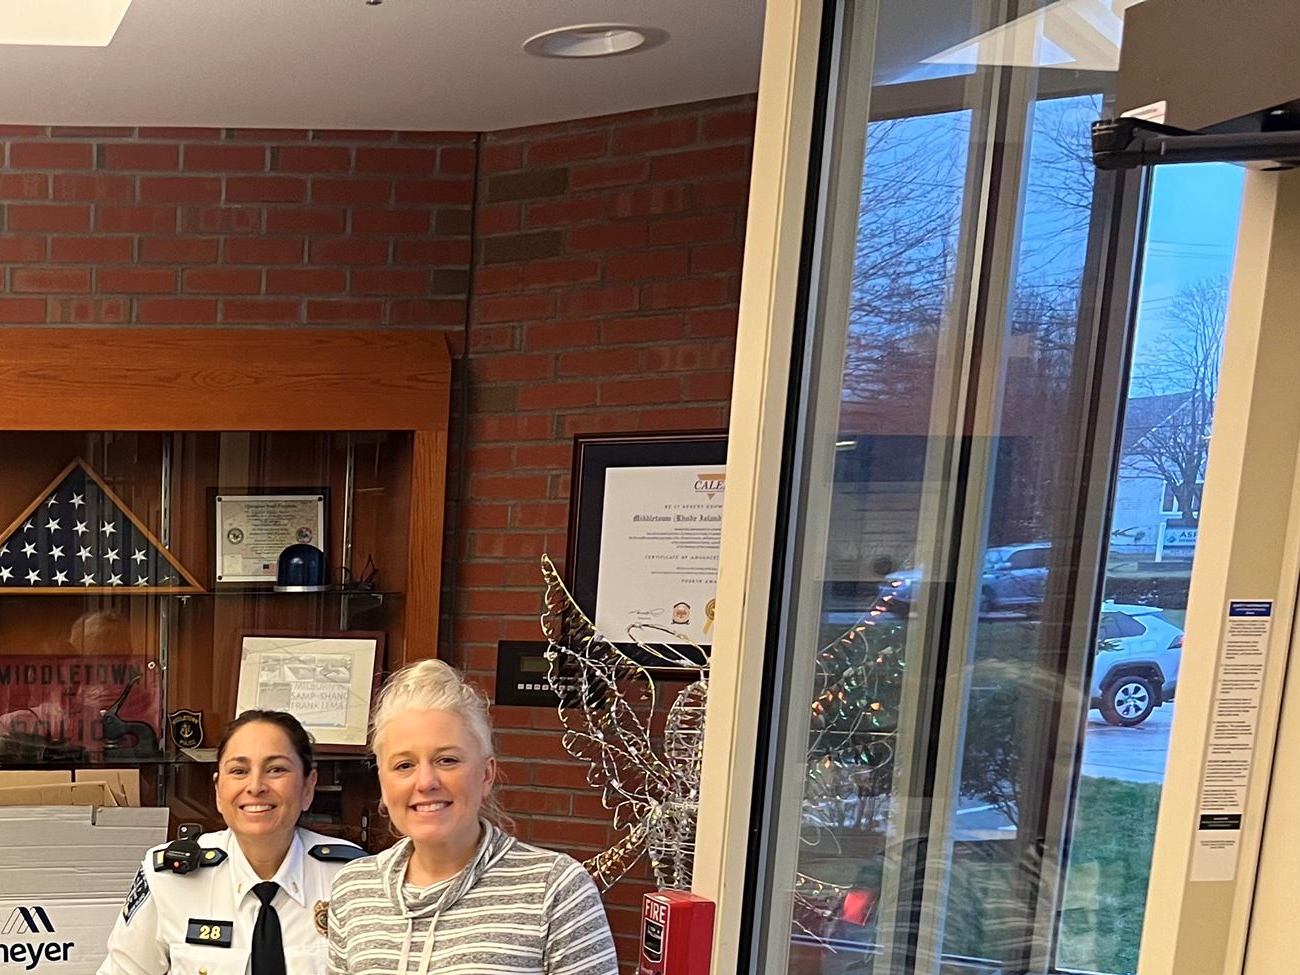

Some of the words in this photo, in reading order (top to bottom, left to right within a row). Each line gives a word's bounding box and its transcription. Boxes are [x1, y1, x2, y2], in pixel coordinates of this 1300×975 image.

[694, 480, 725, 490] CALE
[645, 900, 667, 924] FIRE
[199, 925, 221, 940] 28
